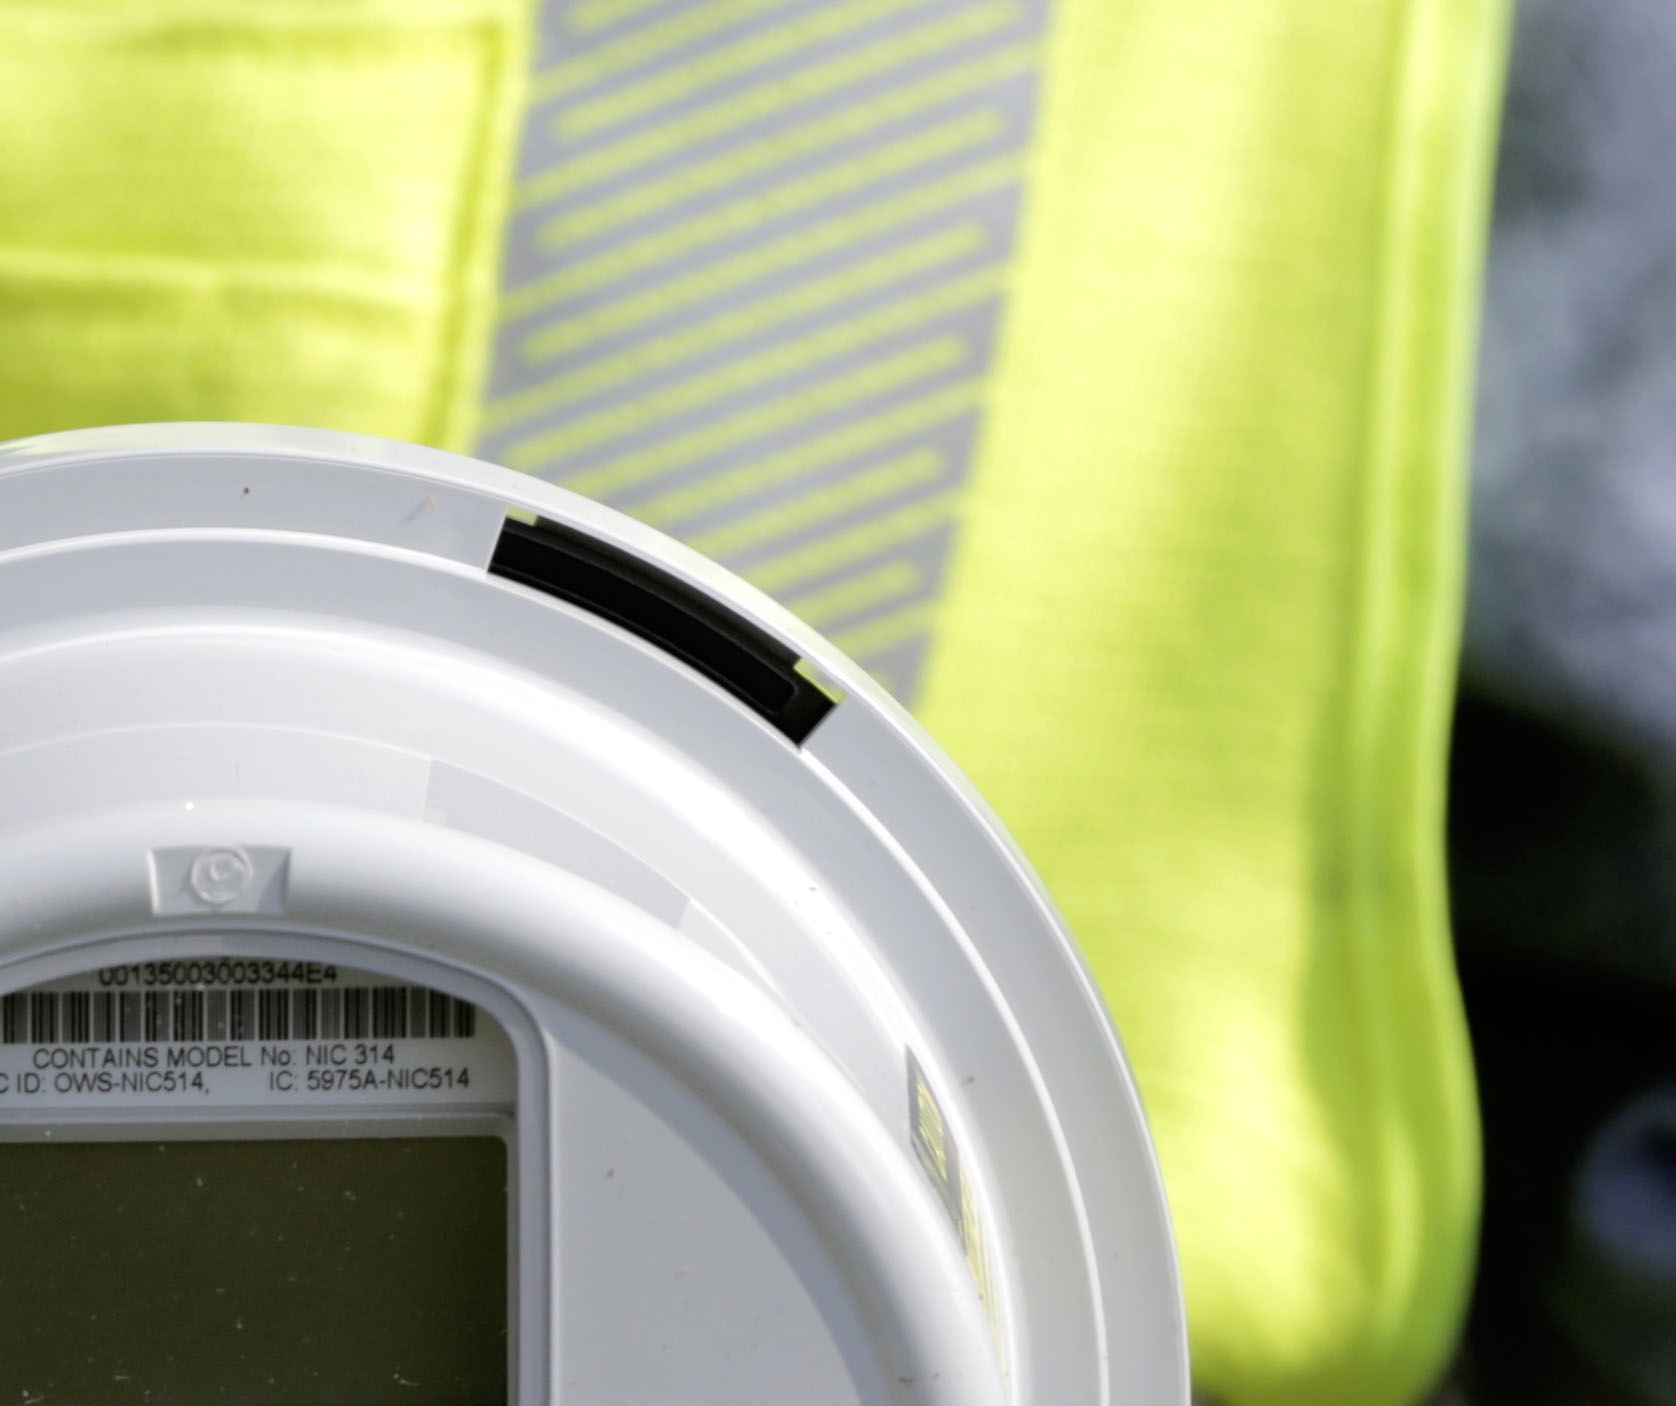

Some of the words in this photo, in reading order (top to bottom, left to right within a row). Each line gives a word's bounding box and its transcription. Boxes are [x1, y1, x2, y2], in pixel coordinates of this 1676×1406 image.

[33, 1047, 159, 1070] CONTAINS
[167, 1047, 254, 1070] MODEL
[261, 1047, 298, 1068] No:
[306, 1047, 350, 1066] NIC
[355, 1045, 395, 1065] 314
[17, 1073, 48, 1094] ID:
[54, 1071, 211, 1096] OWS-NIC514,
[269, 1071, 298, 1092] IC:
[307, 1069, 471, 1091] 5975A-NIC514
